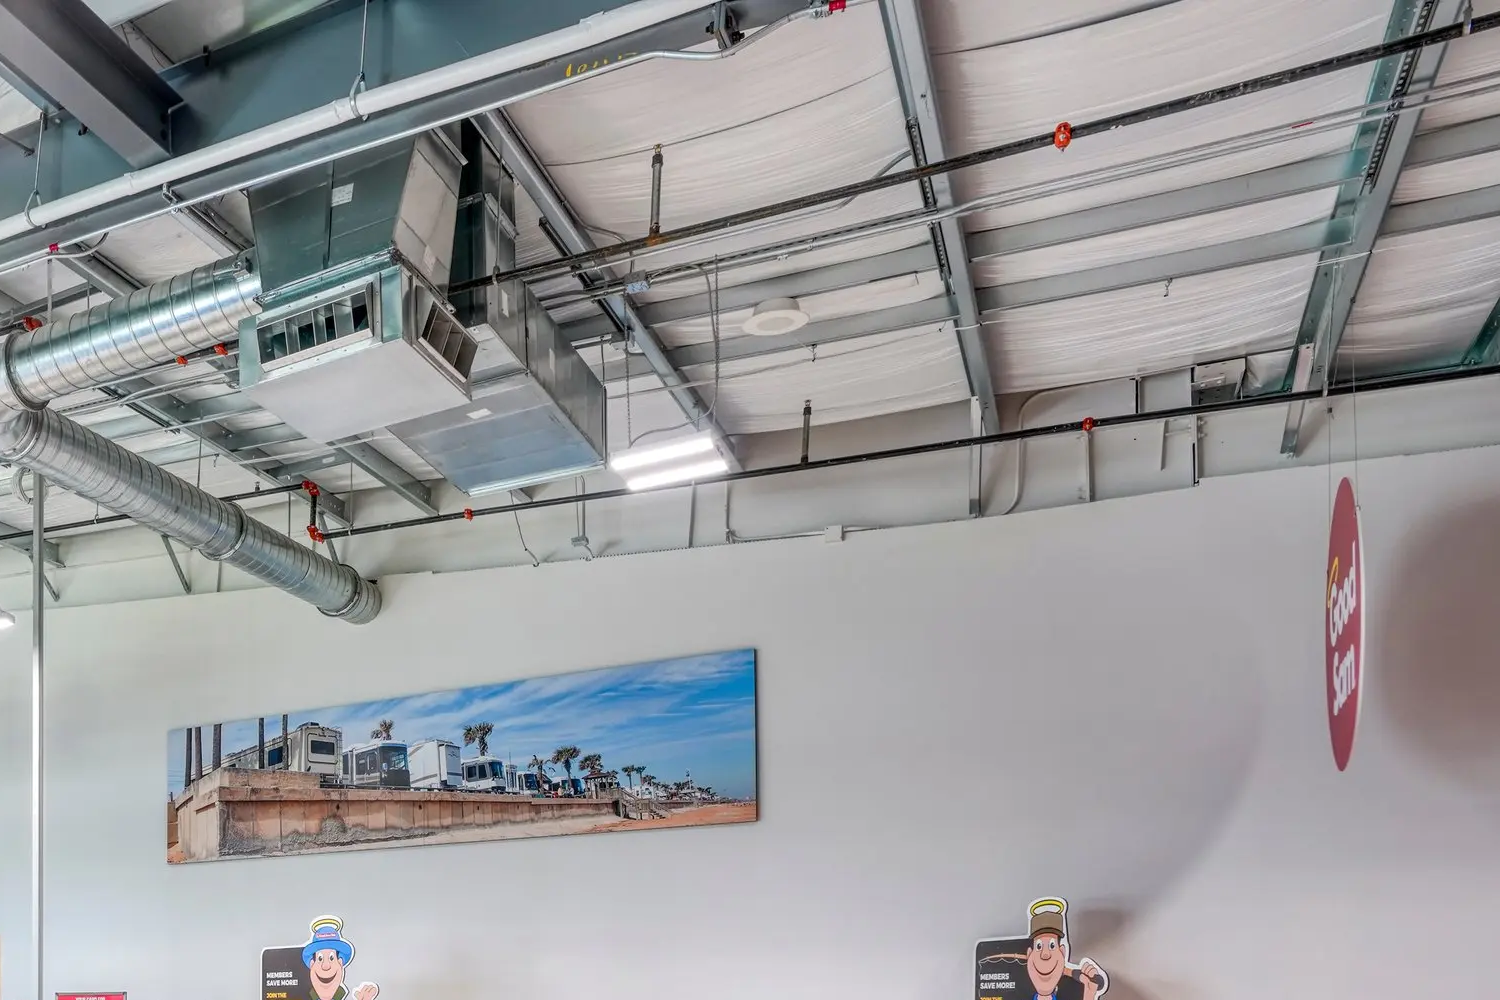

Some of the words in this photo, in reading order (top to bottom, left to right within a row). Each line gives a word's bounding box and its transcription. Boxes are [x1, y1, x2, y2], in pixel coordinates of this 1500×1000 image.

[1329, 540, 1357, 648] Good
[1332, 643, 1357, 716] Sam
[266, 971, 293, 979] MEMBERS
[980, 973, 1010, 981] MEMBERS
[266, 979, 280, 987] SAVE
[996, 981, 1016, 989] MORE!
